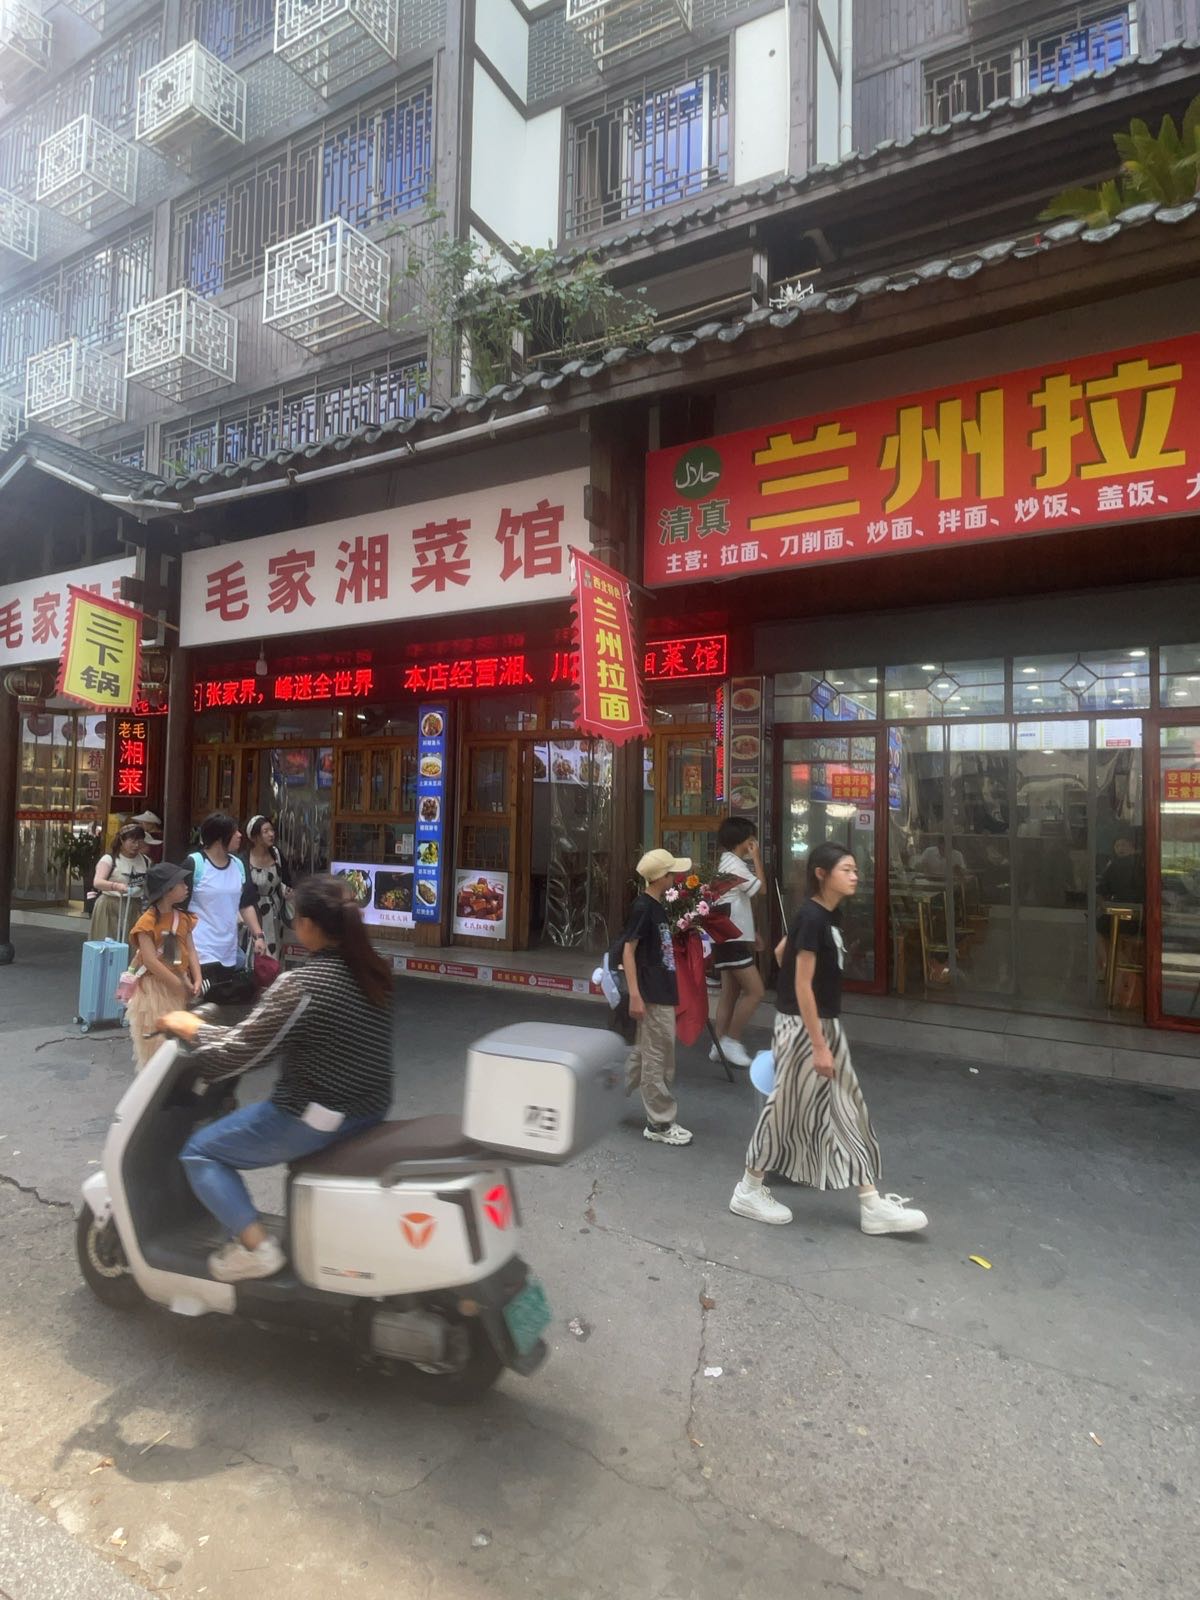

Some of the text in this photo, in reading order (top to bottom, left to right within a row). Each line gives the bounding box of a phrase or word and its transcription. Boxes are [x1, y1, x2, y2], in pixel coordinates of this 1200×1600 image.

[675, 462, 720, 489] حلال
[748, 359, 1186, 532] 兰州拉
[657, 499, 731, 545] 清真
[205, 498, 565, 622] 毛家湘菜馆
[80, 612, 124, 698] 三下锅
[594, 597, 630, 721] 兰州拉面
[118, 721, 146, 739] 老毛
[118, 740, 144, 794] 湘菜
